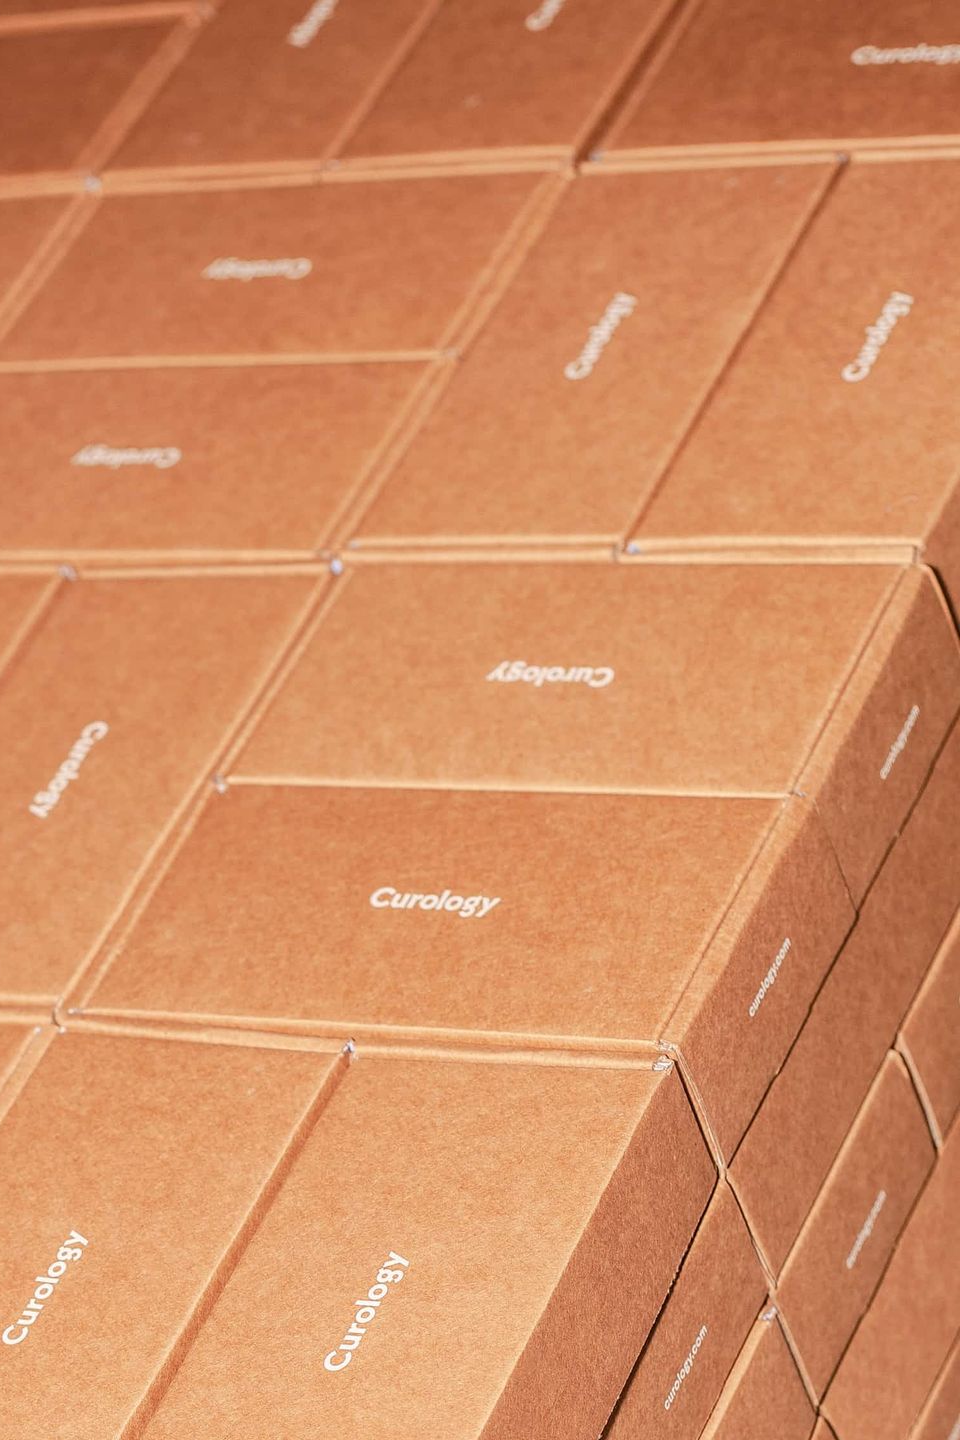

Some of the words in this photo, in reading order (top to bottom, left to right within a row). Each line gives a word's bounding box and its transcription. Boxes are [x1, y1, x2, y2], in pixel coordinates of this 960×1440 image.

[486, 660, 615, 688] Curology
[28, 720, 109, 819] Curology
[369, 886, 501, 918] Curology
[748, 937, 792, 1018] curology.com
[1, 1229, 89, 1346] Curology
[323, 1251, 410, 1372] Curology
[663, 1325, 708, 1411] curology.com
